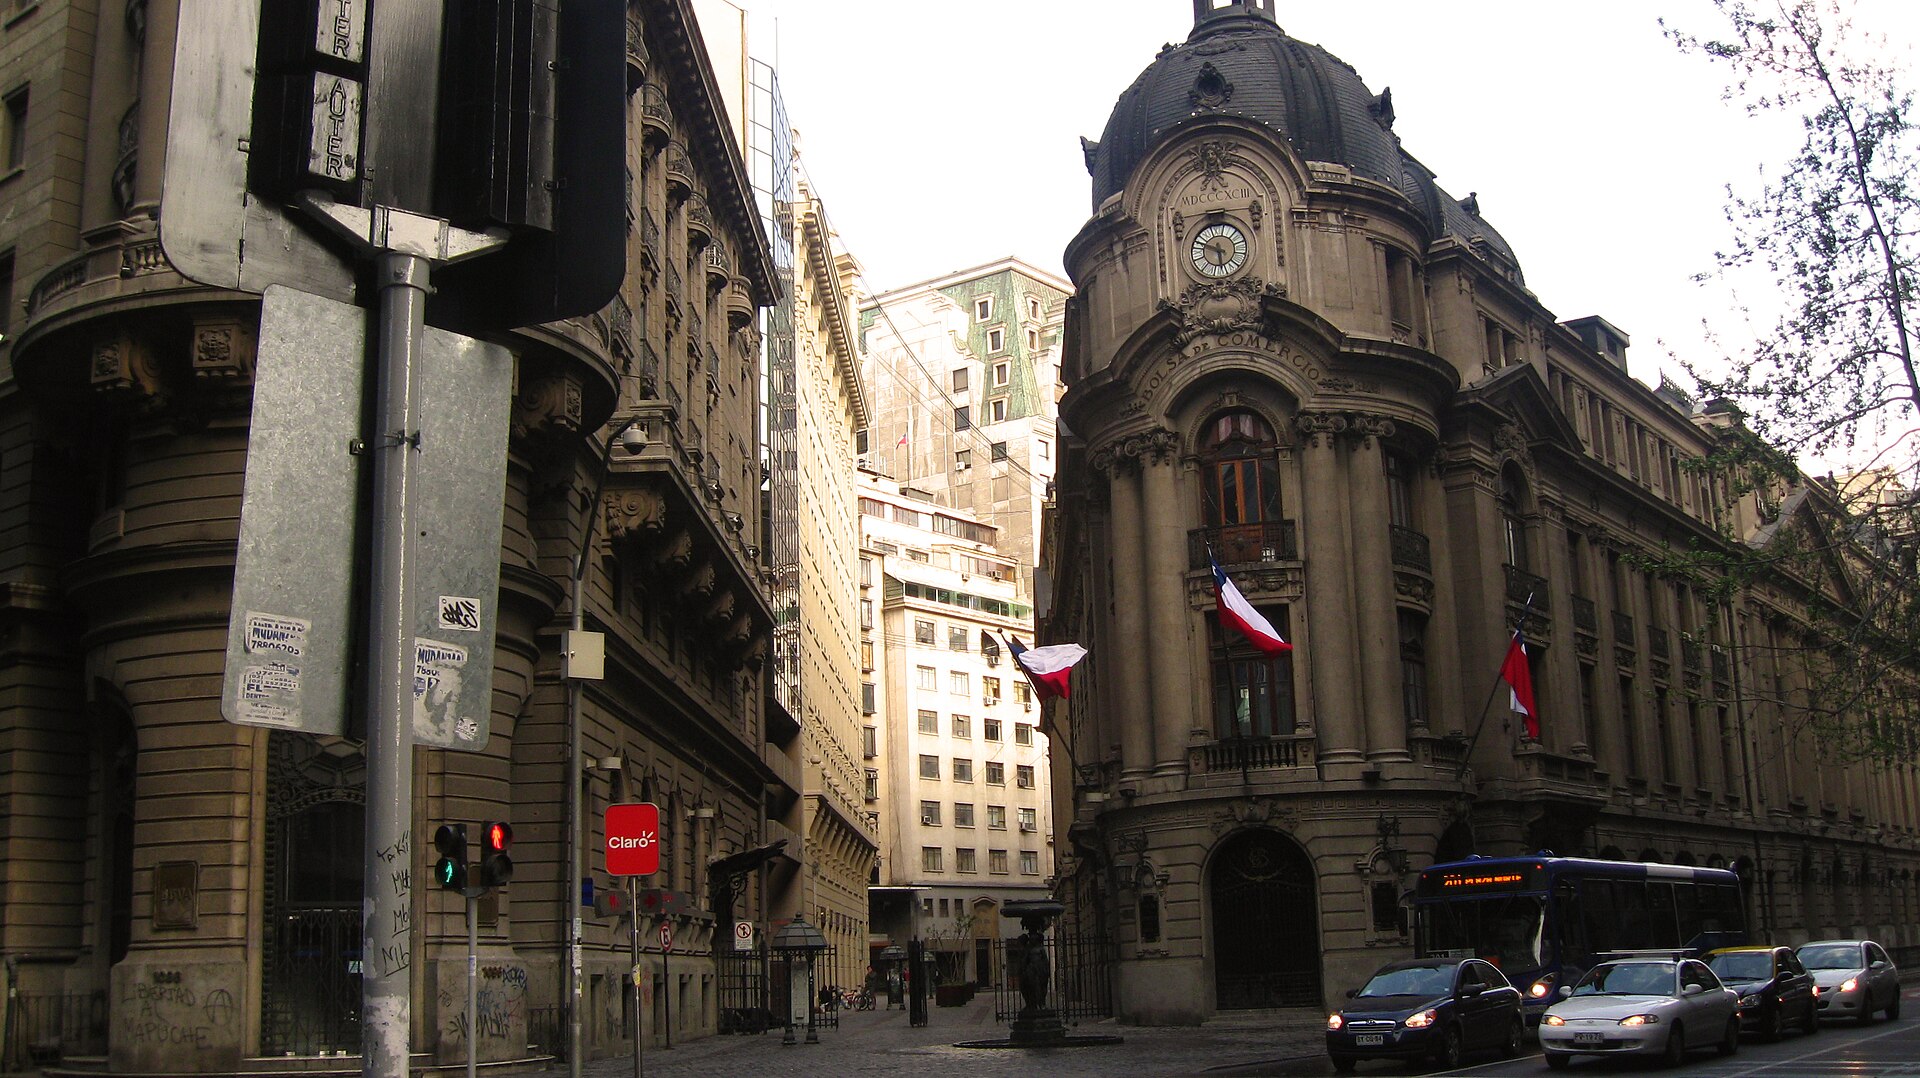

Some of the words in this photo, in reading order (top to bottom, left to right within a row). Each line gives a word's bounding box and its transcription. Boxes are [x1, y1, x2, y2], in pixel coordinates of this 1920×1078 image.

[326, 78, 347, 177] AUTER
[1181, 188, 1250, 207] MDCCCXCIII
[1141, 351, 1190, 402] BOLSA
[1192, 342, 1211, 355] DE
[1217, 332, 1320, 381] COMERCIO
[608, 834, 651, 849] Claro
